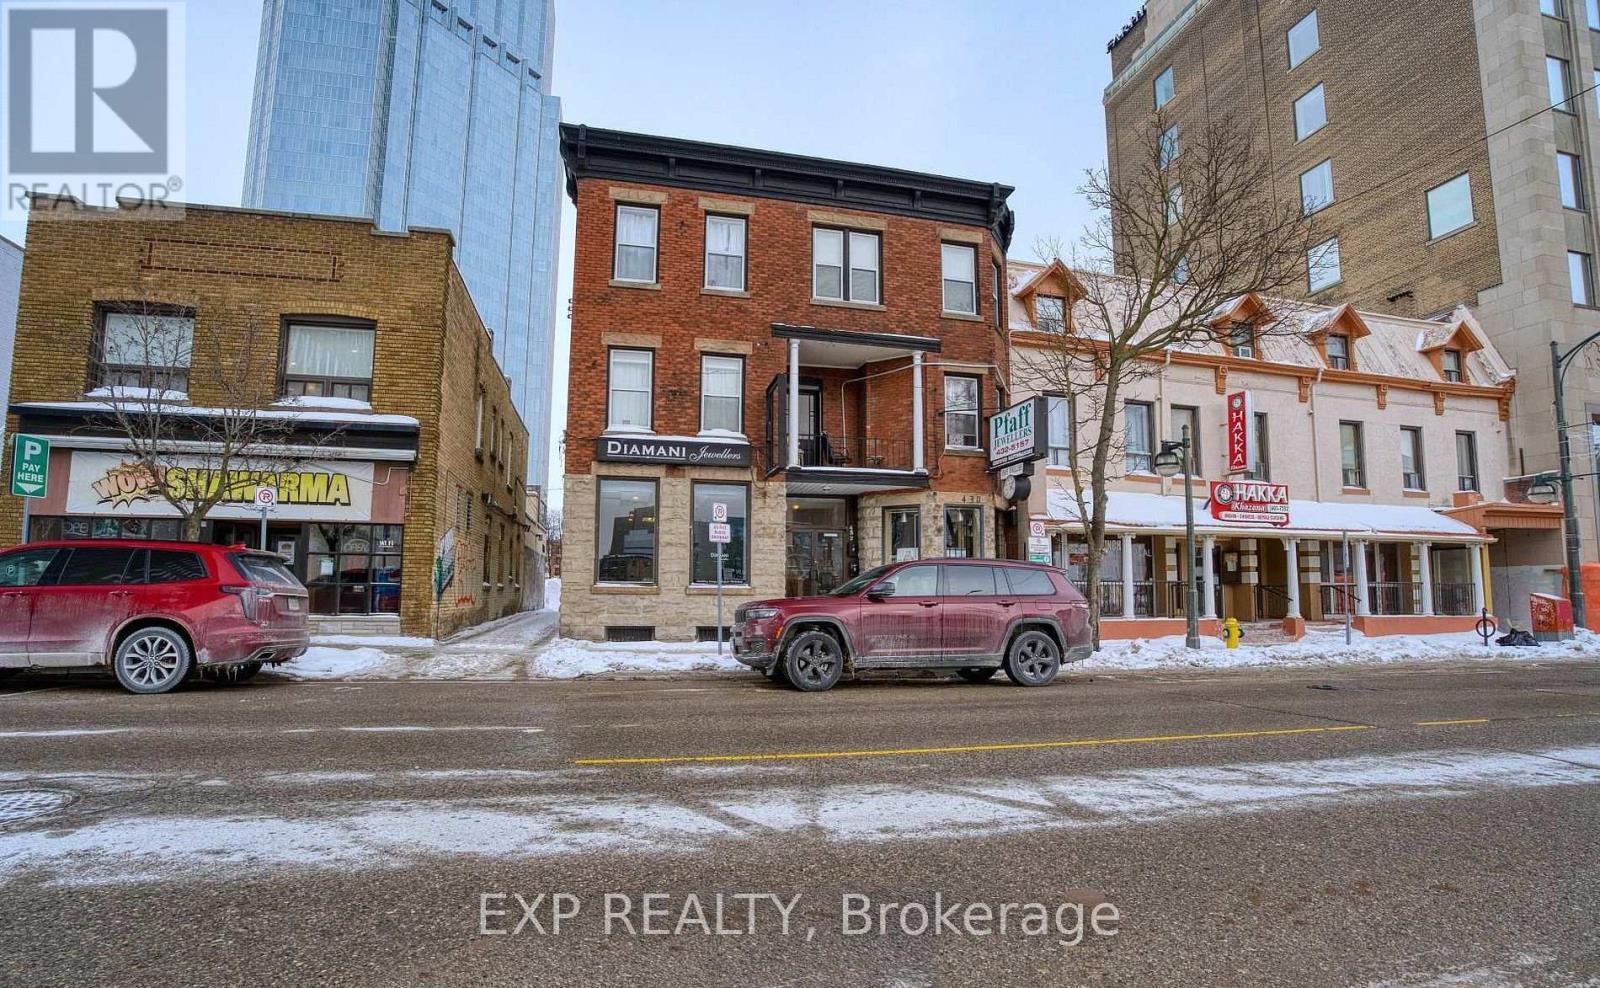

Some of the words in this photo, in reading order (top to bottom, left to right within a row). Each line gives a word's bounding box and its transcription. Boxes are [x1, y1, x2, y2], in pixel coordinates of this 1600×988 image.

[993, 402, 1032, 439] Pfaff
[993, 427, 1032, 448] JEWELLERS
[1231, 411, 1244, 465] HAKKA
[24, 440, 42, 460] P
[607, 441, 686, 458] DIAMANI
[689, 445, 741, 462] Jewellers
[17, 472, 44, 483] HERE
[22, 462, 41, 473] PAY
[1234, 483, 1288, 503] HAKKA
